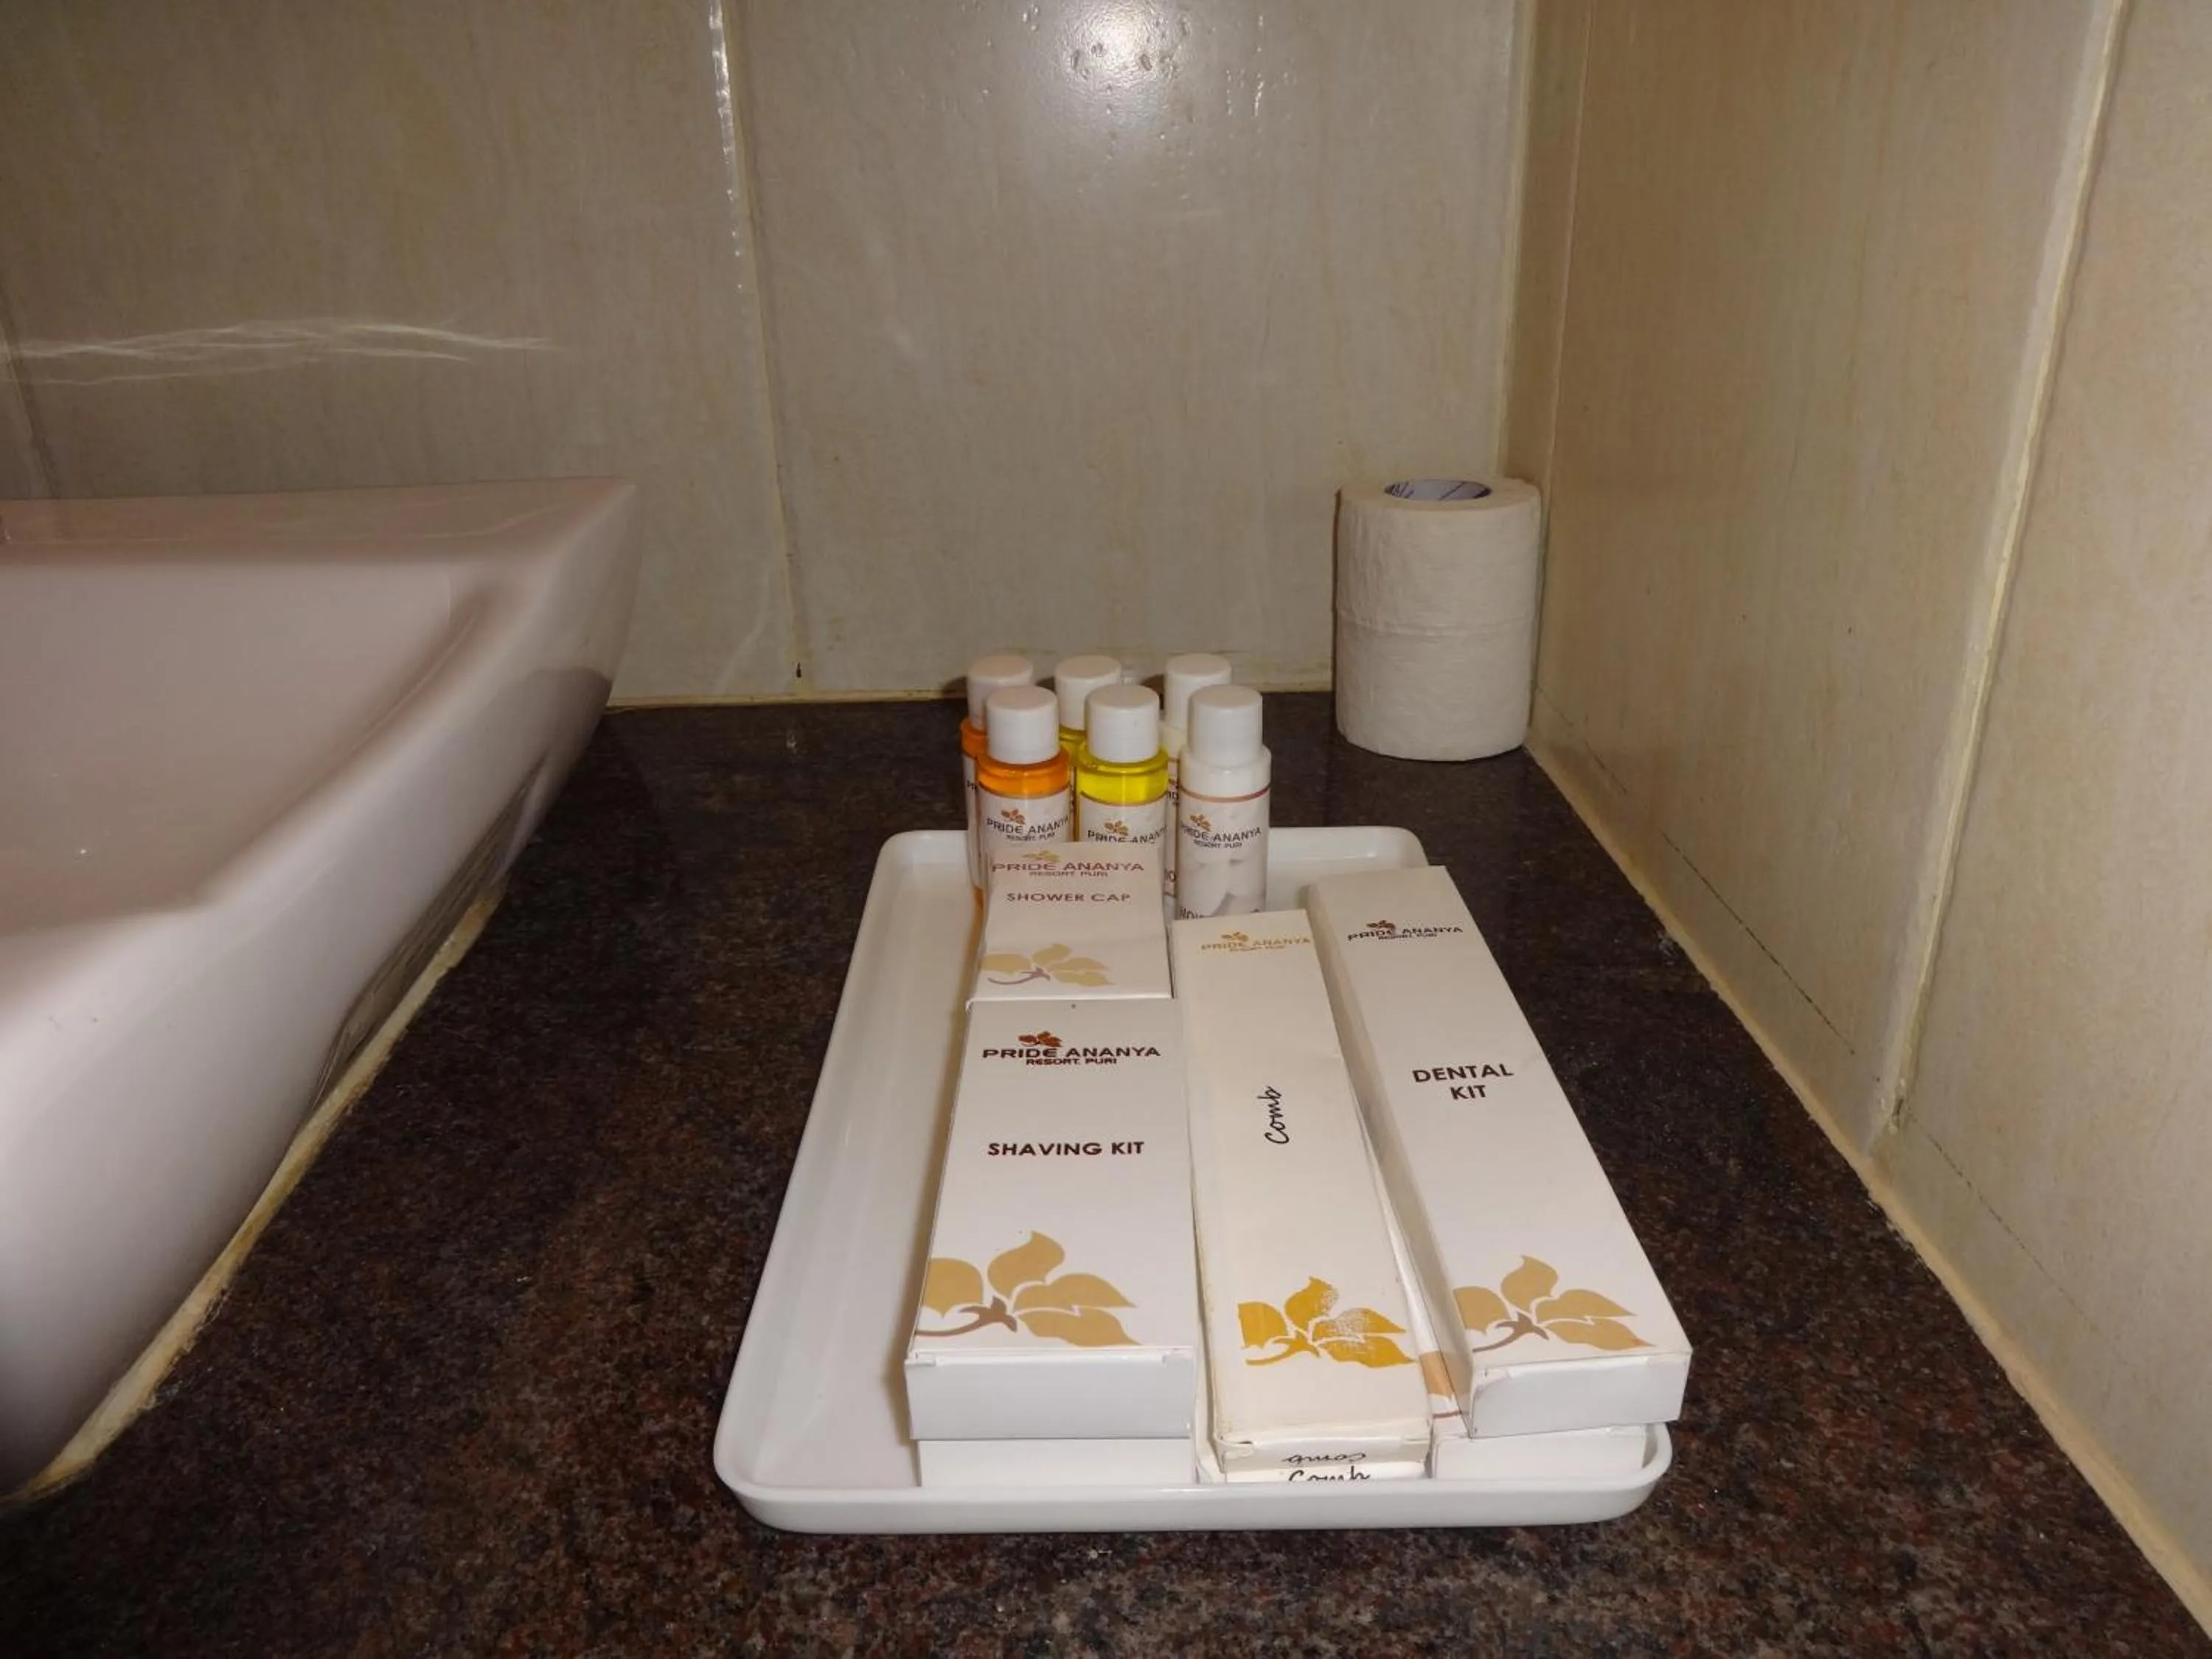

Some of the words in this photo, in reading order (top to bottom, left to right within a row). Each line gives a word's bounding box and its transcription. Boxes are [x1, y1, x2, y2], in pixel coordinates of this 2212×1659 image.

[986, 817, 1023, 835] PRIDE
[1213, 826, 1262, 843] ANANYA
[992, 863, 1057, 872] PRIDE
[1063, 861, 1144, 872] ANANYA
[1006, 893, 1085, 902] SHOWER
[1091, 893, 1131, 902] CAP
[1348, 929, 1394, 940] PRIDE
[1402, 926, 1463, 934] ANANYA
[1253, 937, 1311, 946] ANANYA
[982, 1048, 1057, 1059] PRIDE
[1067, 1046, 1161, 1057] ANANYA
[1412, 1063, 1514, 1083] DENTAL
[1450, 1085, 1486, 1100] KIT
[1256, 1085, 1290, 1145] Comb
[987, 1142, 1102, 1156] SHAVING
[1110, 1141, 1144, 1155] KIT
